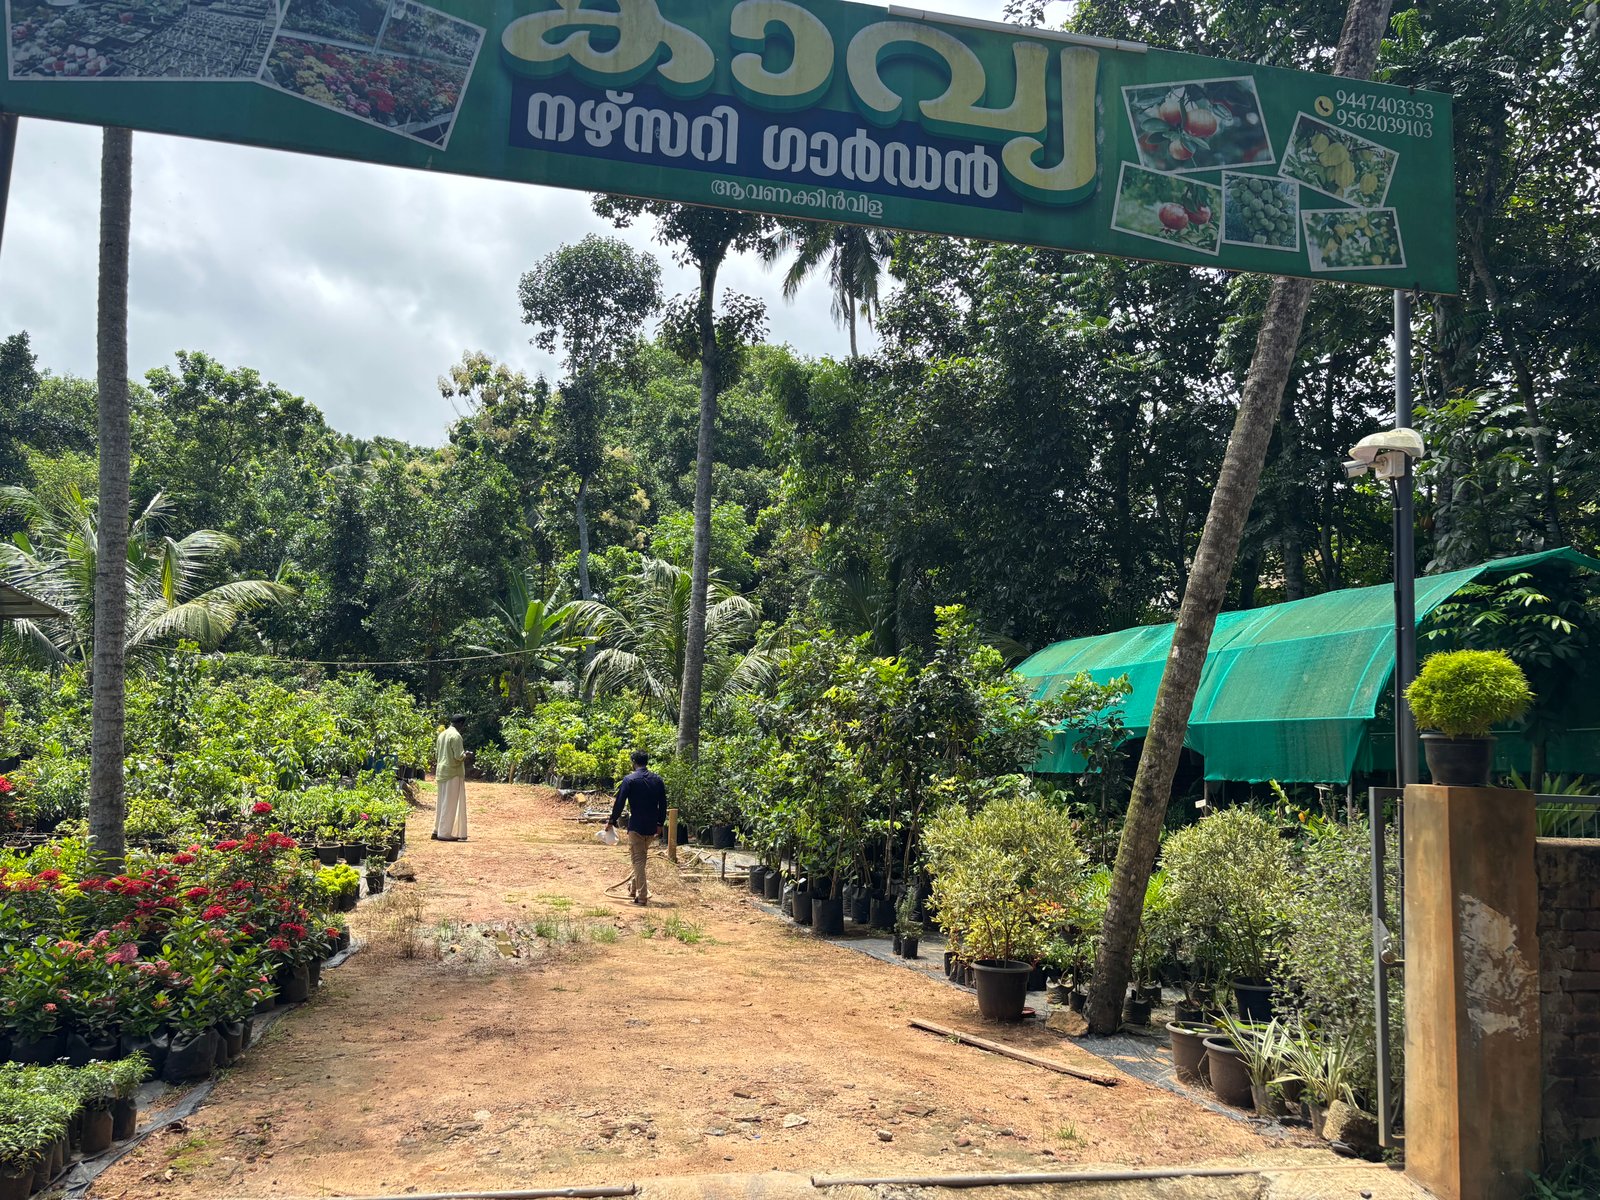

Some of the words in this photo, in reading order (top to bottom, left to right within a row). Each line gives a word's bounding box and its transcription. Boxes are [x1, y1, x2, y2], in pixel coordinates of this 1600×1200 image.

[1336, 90, 1434, 120] 9447403353
[1336, 109, 1433, 138] 9562039103
[527, 89, 739, 165] നഴ്സറി
[762, 125, 998, 198] ഗാർഡൻ
[711, 179, 883, 218] ആവണക്കിൻവിള
